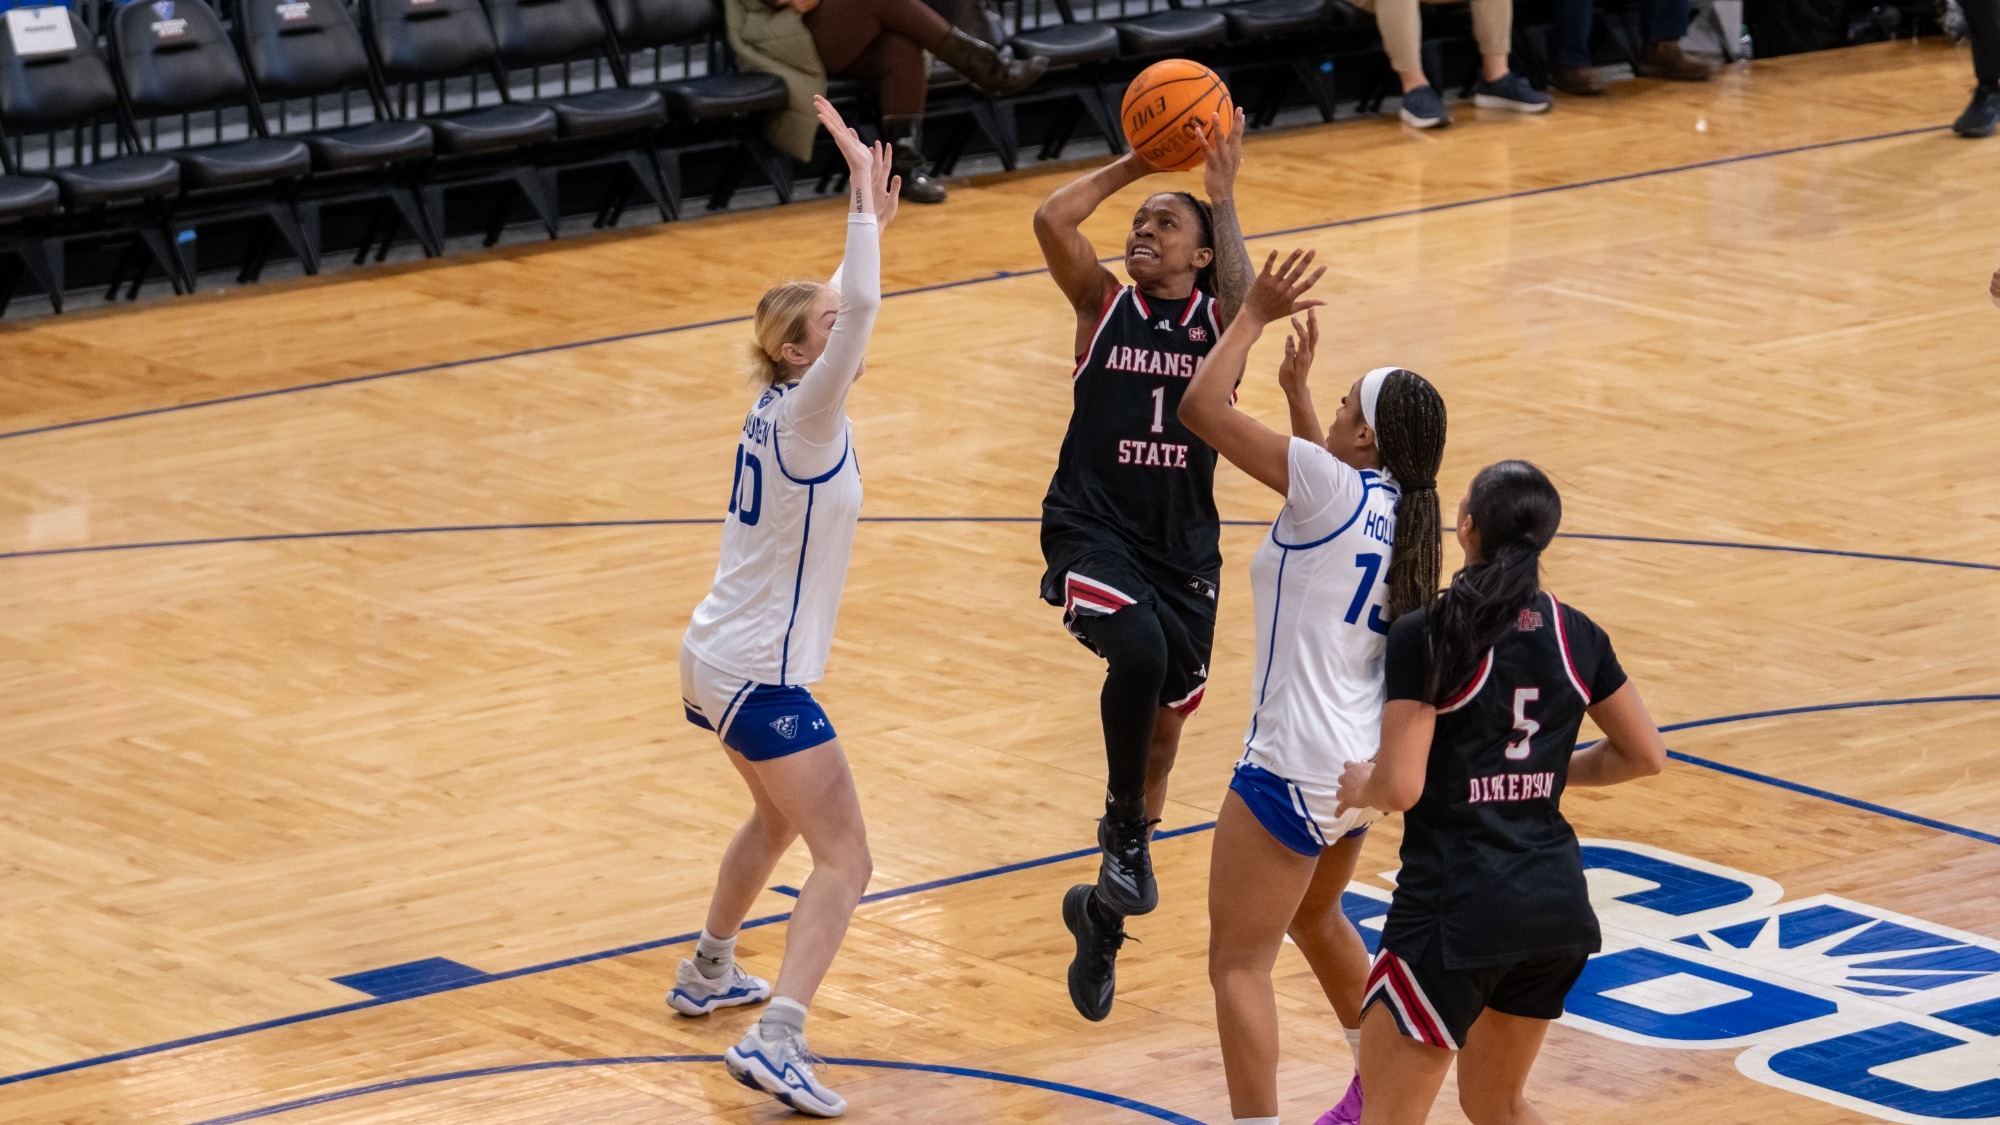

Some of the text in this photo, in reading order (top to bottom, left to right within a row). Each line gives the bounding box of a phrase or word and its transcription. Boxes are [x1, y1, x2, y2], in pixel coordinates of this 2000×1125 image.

[1151, 385, 1165, 433] 1
[1118, 439, 1188, 469] STATE
[1504, 688, 1540, 760] 5
